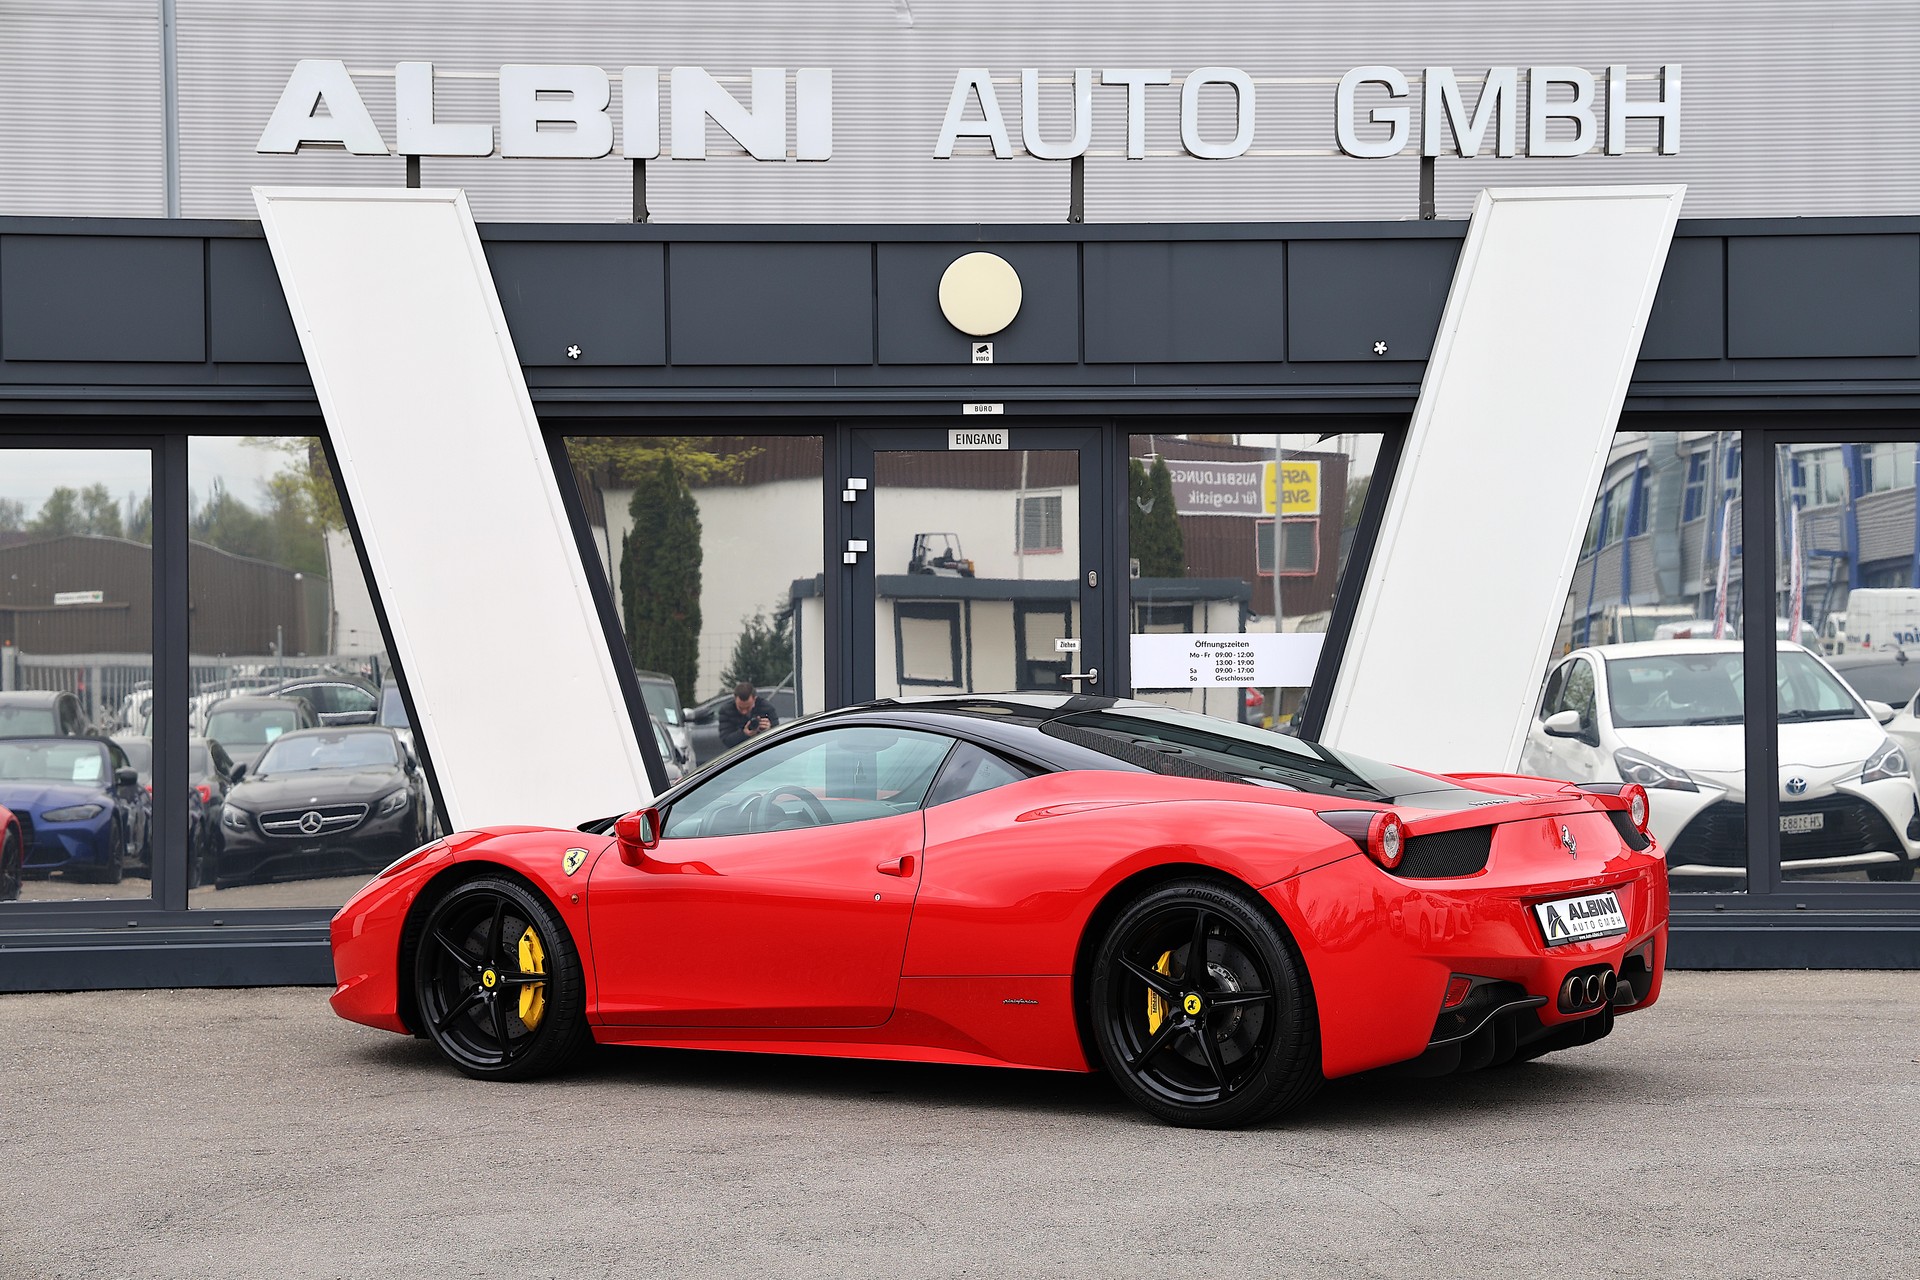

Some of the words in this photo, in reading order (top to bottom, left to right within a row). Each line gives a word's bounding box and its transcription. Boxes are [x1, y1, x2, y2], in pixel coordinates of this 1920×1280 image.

[255, 59, 833, 162] ALBINI
[932, 66, 1256, 161] AUTO
[1333, 63, 1683, 158] GMBH
[974, 404, 993, 413] BÜRO
[955, 433, 1002, 445] EINGANG
[1060, 641, 1077, 649] Ziehen
[1194, 640, 1250, 649] Öffnungszeiten
[1568, 897, 1617, 920] ALBINI
[1572, 920, 1596, 933] AUTO
[1598, 916, 1622, 928] GMBH
